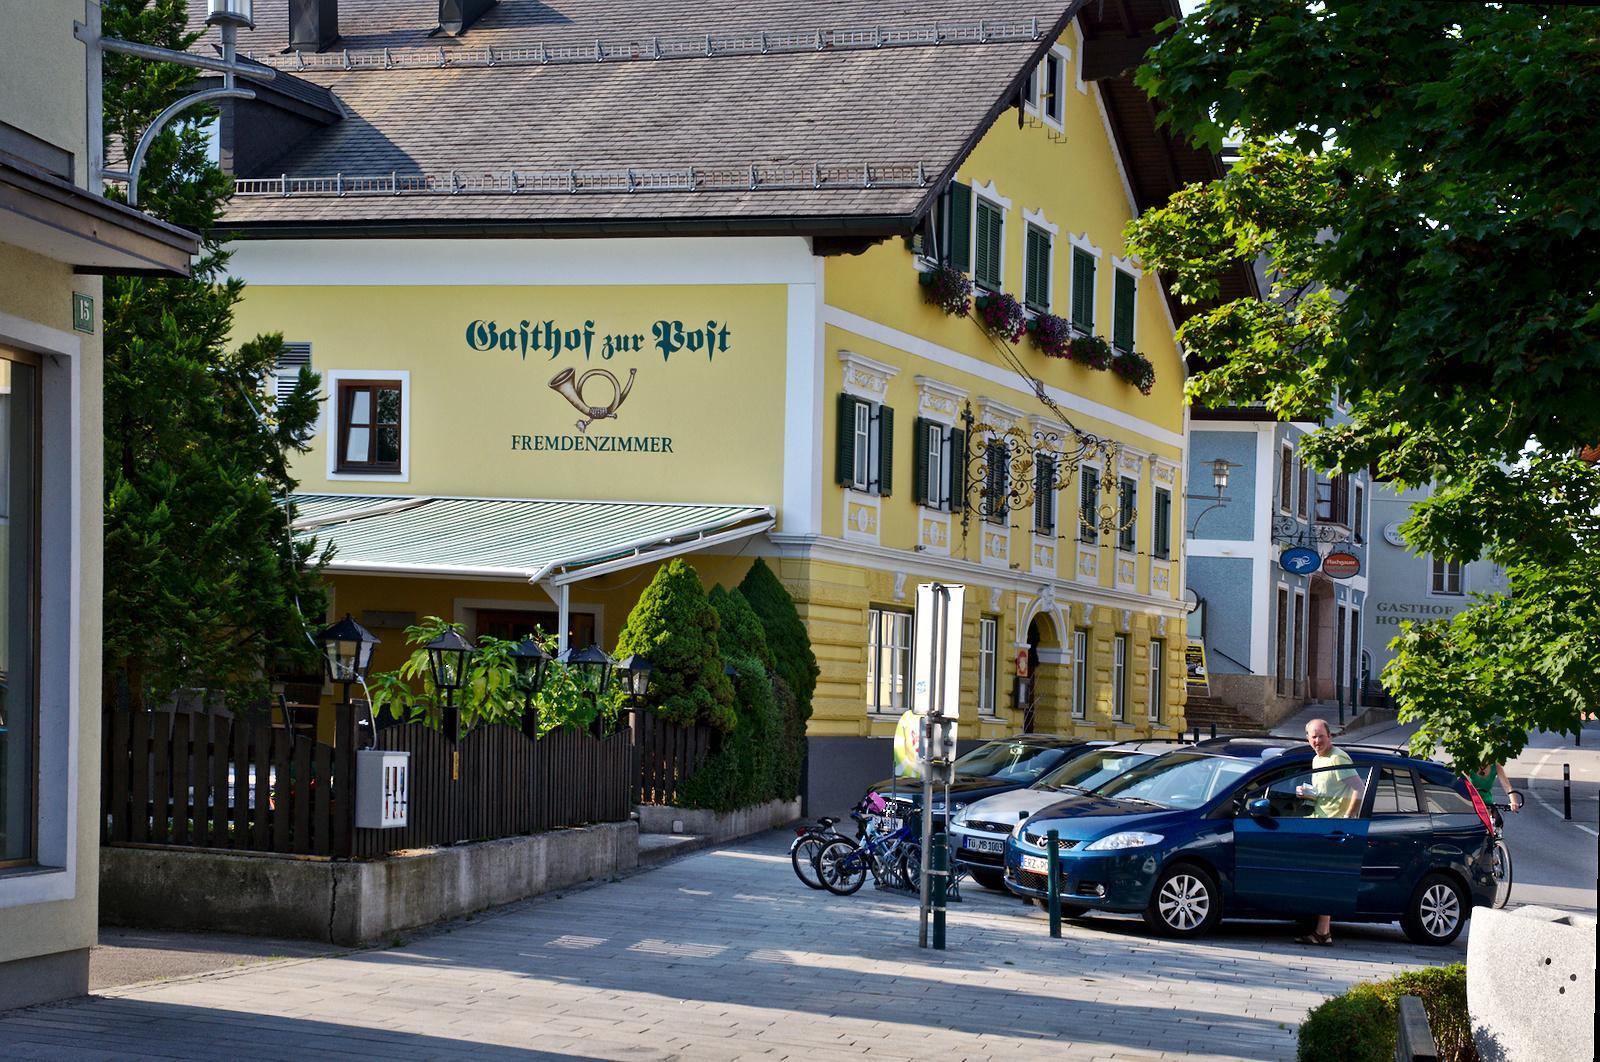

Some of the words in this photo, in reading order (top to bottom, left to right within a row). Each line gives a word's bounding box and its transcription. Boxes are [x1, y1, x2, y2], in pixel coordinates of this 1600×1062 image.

[80, 300, 90, 320] 15
[465, 319, 595, 362] Gasthof
[602, 333, 645, 361] zur
[652, 319, 731, 362] Post
[511, 434, 674, 453] FREMDENZIMMER
[1376, 601, 1454, 615] GASTHOF
